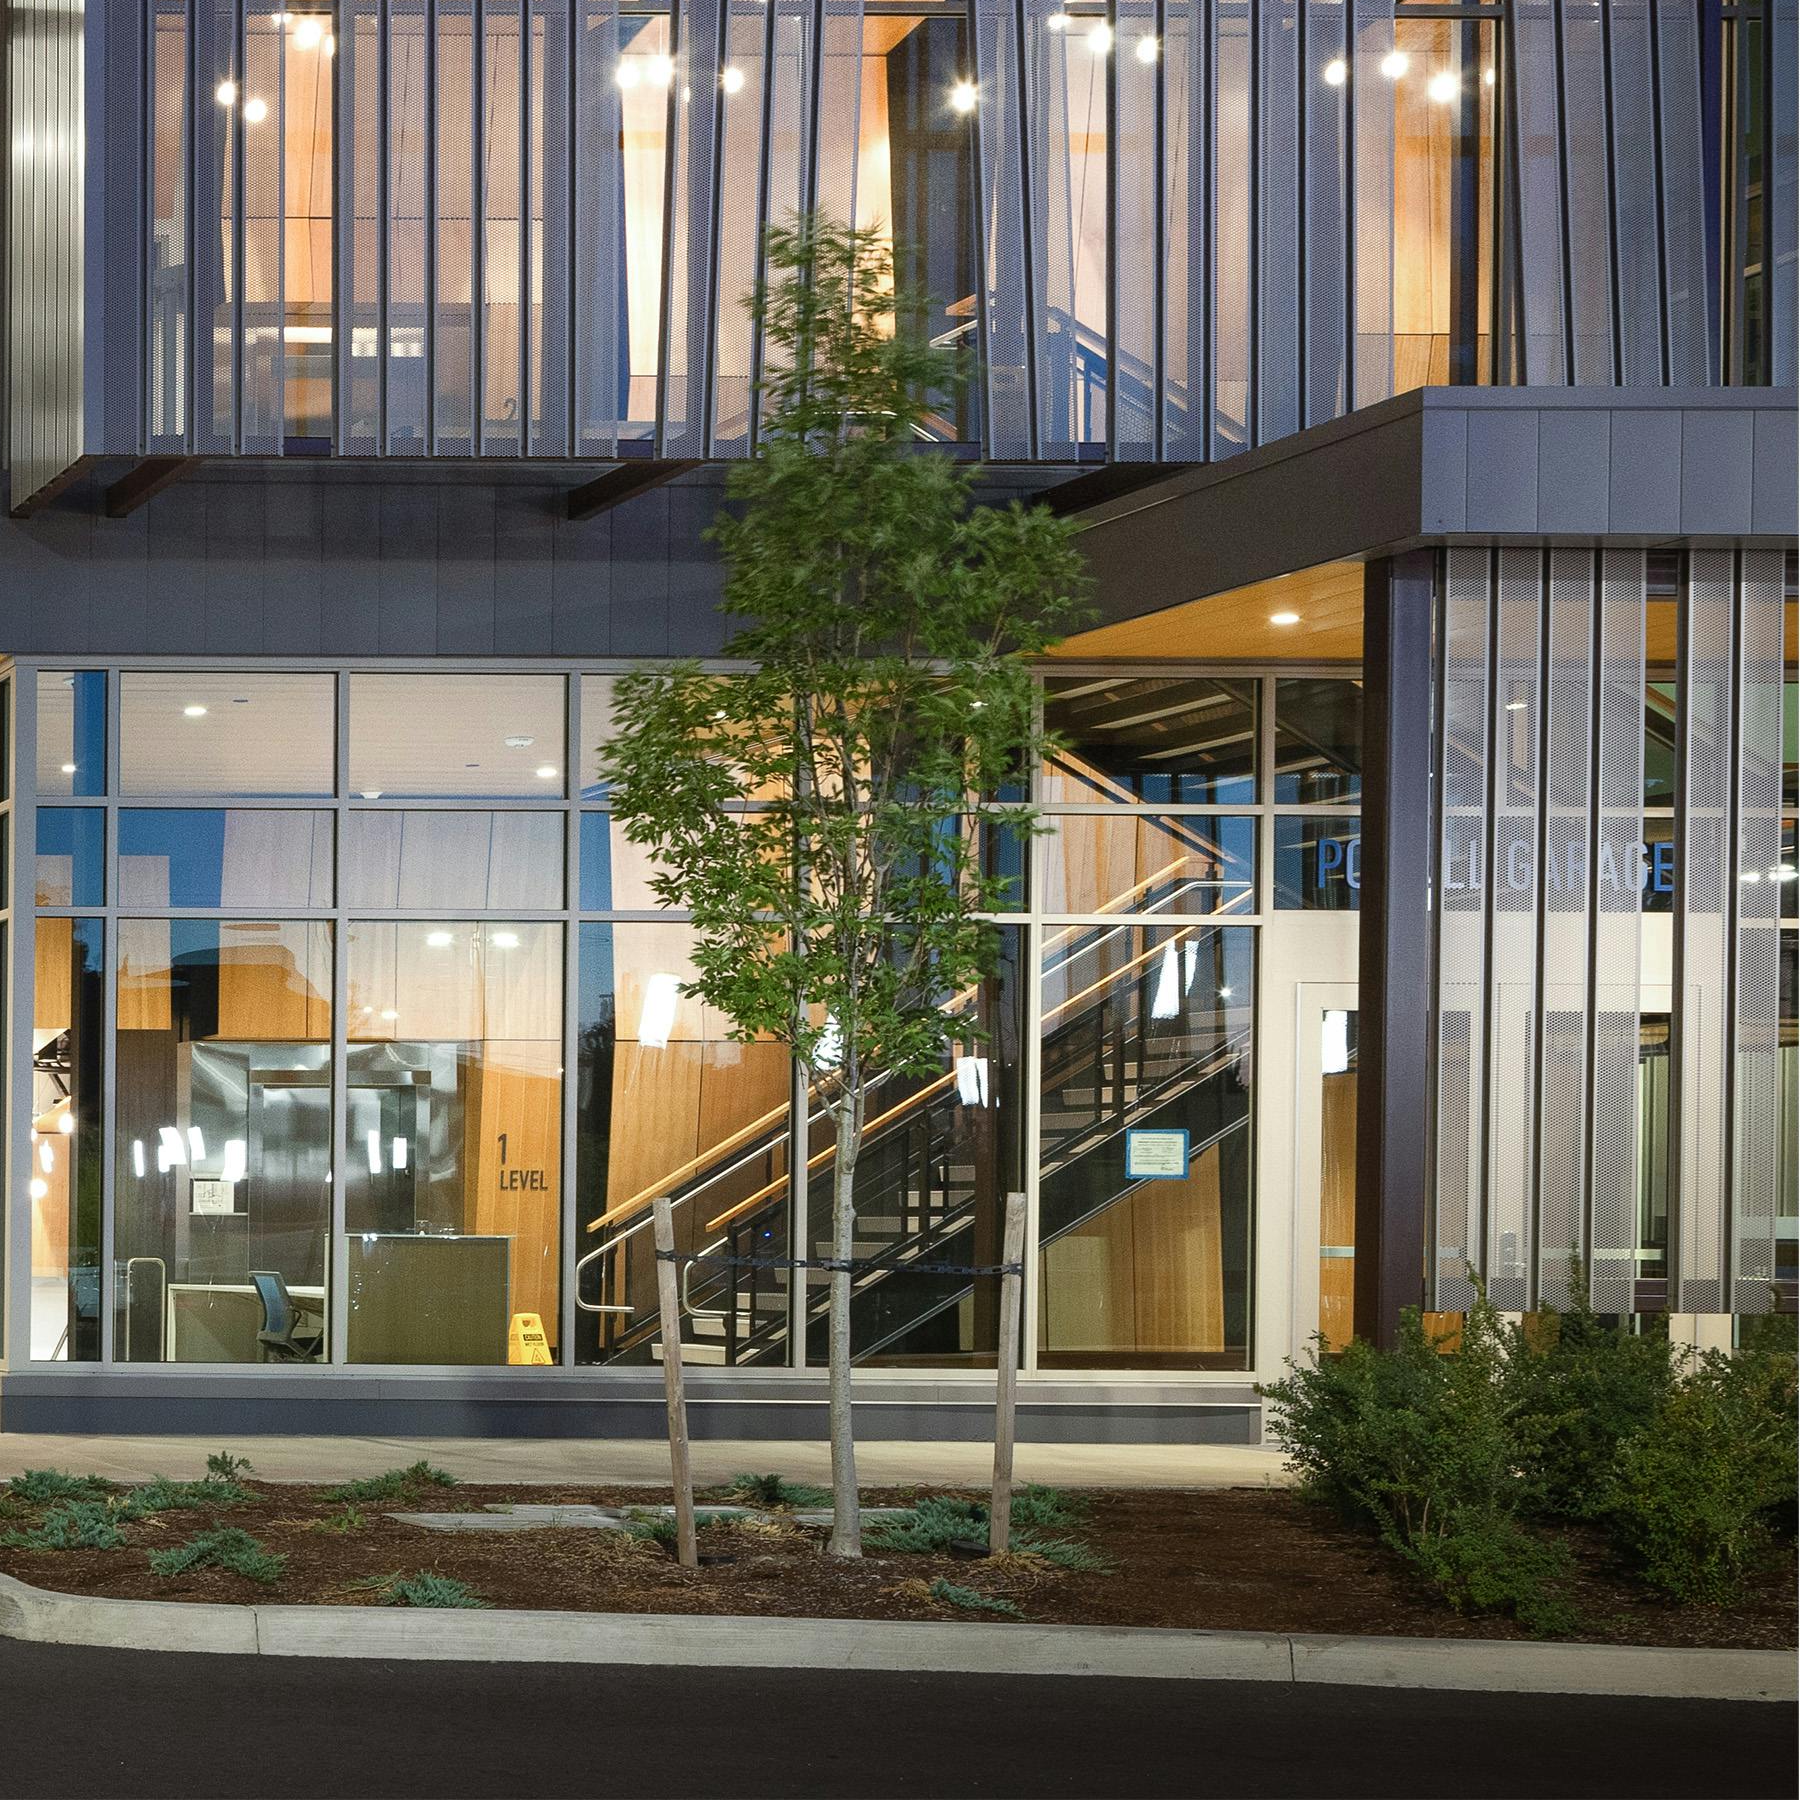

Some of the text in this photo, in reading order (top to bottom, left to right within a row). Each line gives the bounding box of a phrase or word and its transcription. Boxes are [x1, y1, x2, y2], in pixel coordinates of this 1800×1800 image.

[1317, 838, 1484, 890] POLL
[497, 1133, 508, 1165] 1
[499, 1170, 549, 1192] LEVEL
